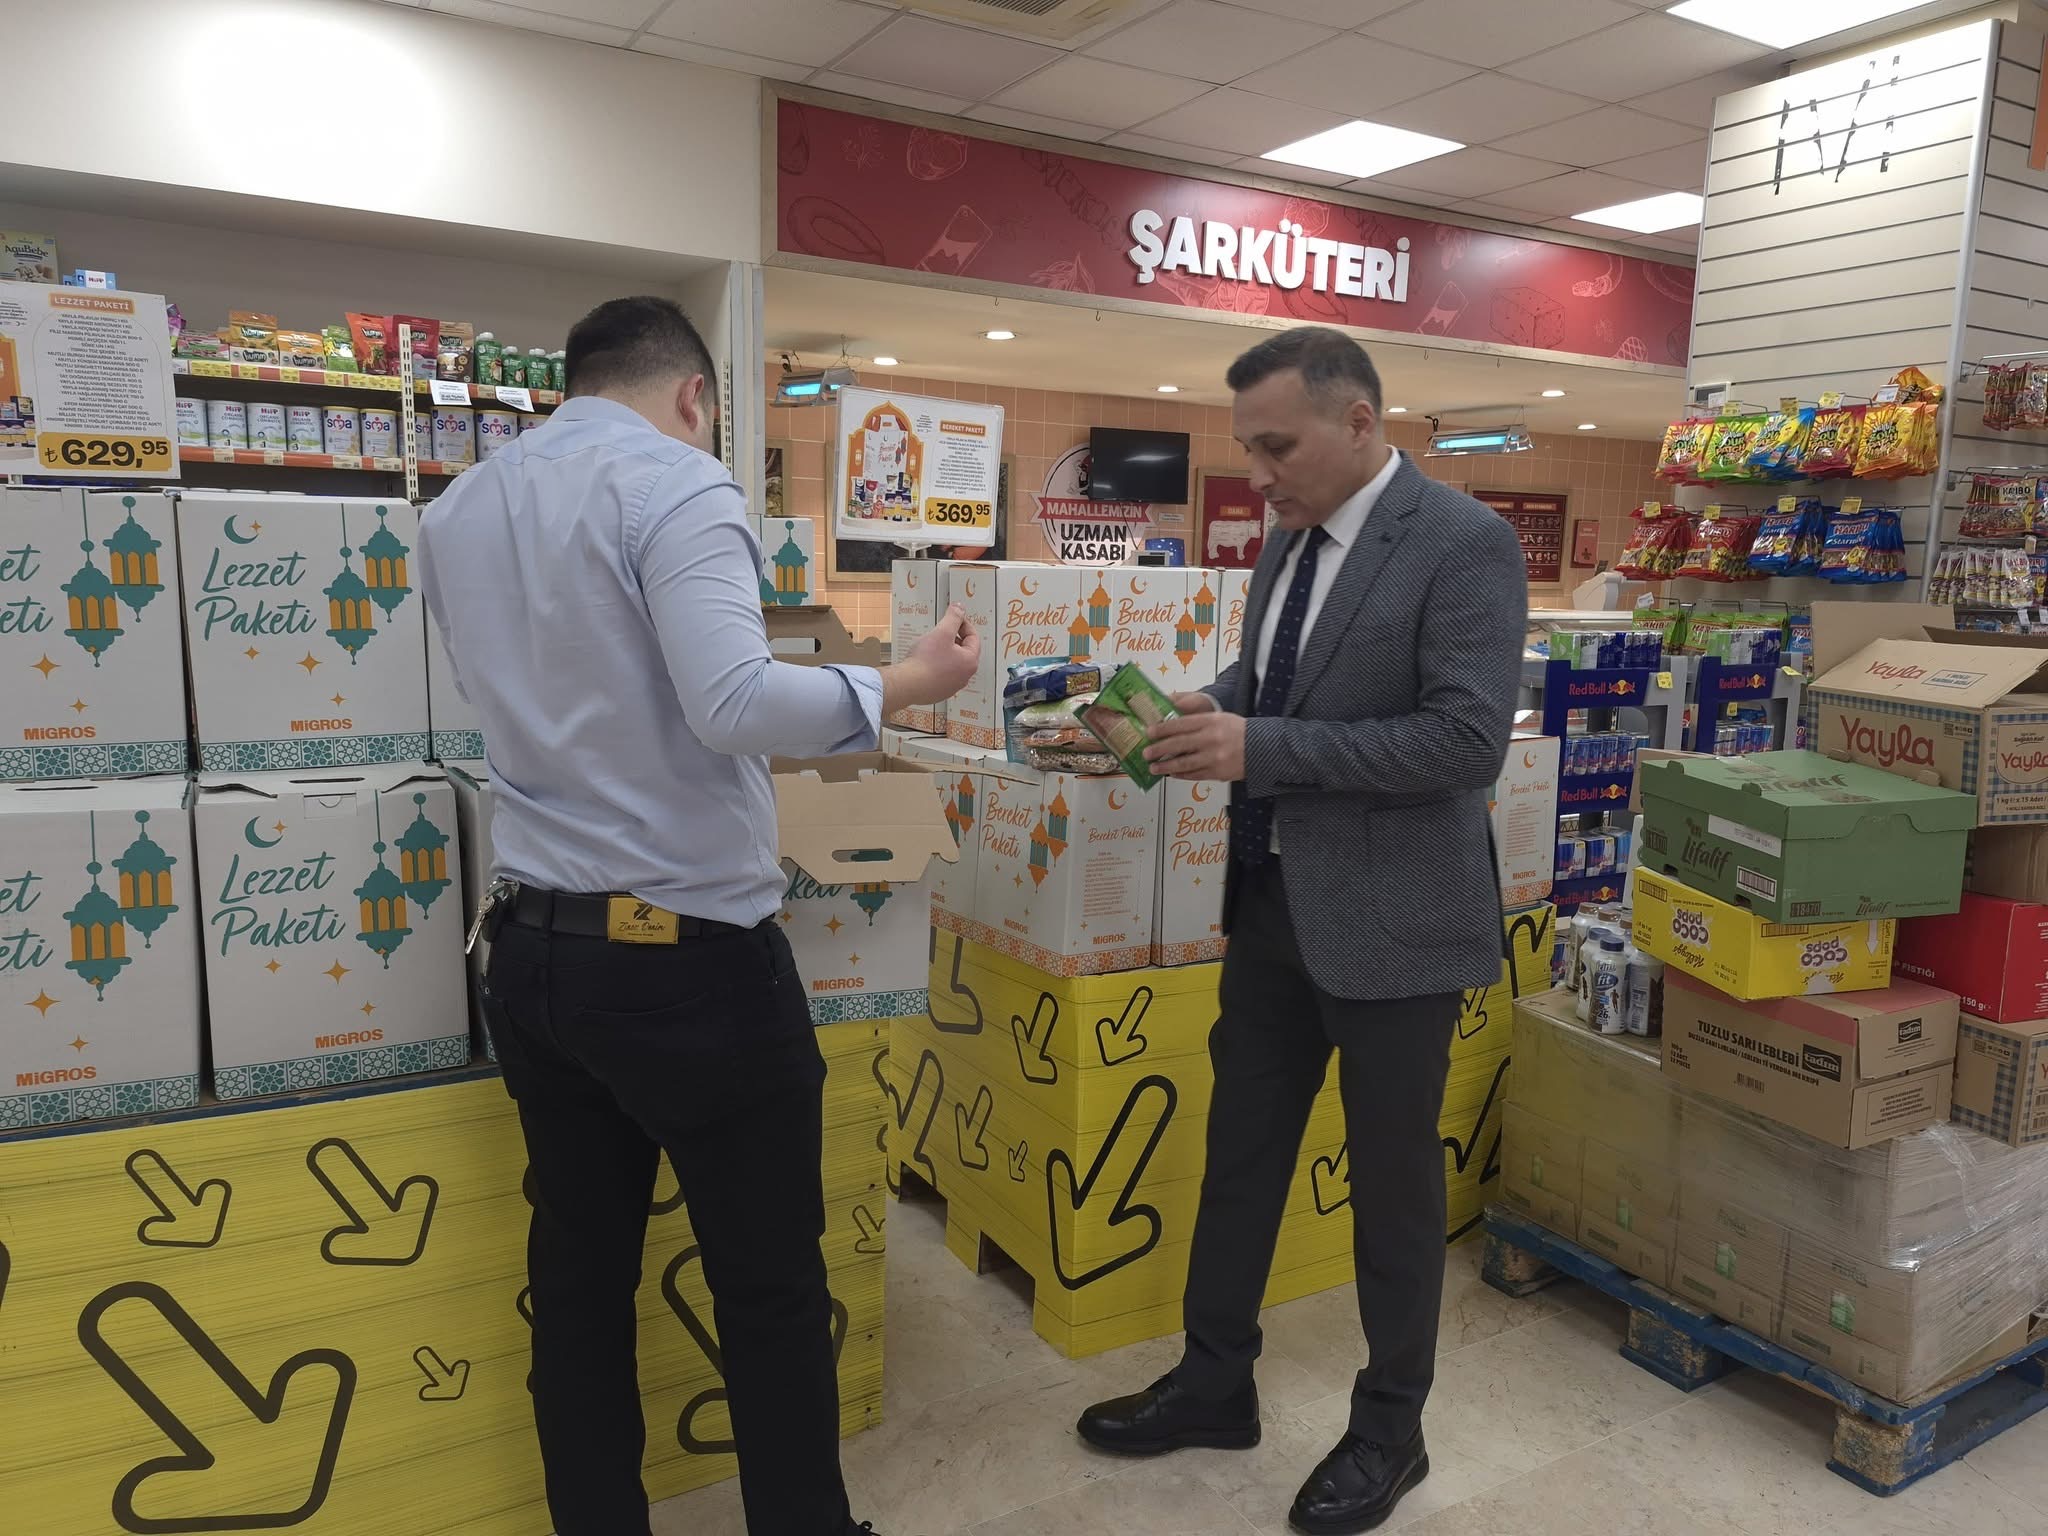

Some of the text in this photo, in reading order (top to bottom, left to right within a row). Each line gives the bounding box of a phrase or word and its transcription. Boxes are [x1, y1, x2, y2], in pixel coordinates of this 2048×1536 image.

[1128, 209, 1410, 303] ŞARKÜTERİ
[54, 297, 130, 310] LEZZET PAKETİ
[436, 415, 466, 432] sma
[482, 418, 510, 436] sma
[1060, 524, 1127, 542] UZMAN
[1060, 543, 1126, 560] KASABI
[202, 547, 307, 594] Lezzet
[194, 596, 317, 641] Paketi
[1006, 600, 1069, 628] Bereket
[1118, 600, 1176, 625] Bereket
[1002, 631, 1058, 659] Paketi
[1113, 628, 1166, 654] Paketi
[1865, 660, 1928, 680] Yayla
[1840, 714, 1935, 767] Yayla
[985, 792, 1033, 829] Bereket
[1176, 806, 1231, 838] Bereke
[982, 824, 1021, 859] Paketi
[1088, 826, 1146, 844] Bereket Paketi
[1170, 840, 1230, 872] Paketi
[1682, 838, 1733, 880] Lifalif
[219, 851, 336, 904] Lezzet
[211, 904, 346, 958] Paketi
[1806, 936, 1840, 953] pops
[1672, 944, 1705, 968] Kellogg's
[1902, 962, 1935, 979] FISTIĞI
[1962, 996, 1976, 1007] 150
[1698, 1020, 1800, 1067] TUZLU SARI LEBLEBİ
[1803, 1052, 1840, 1073] tadım
